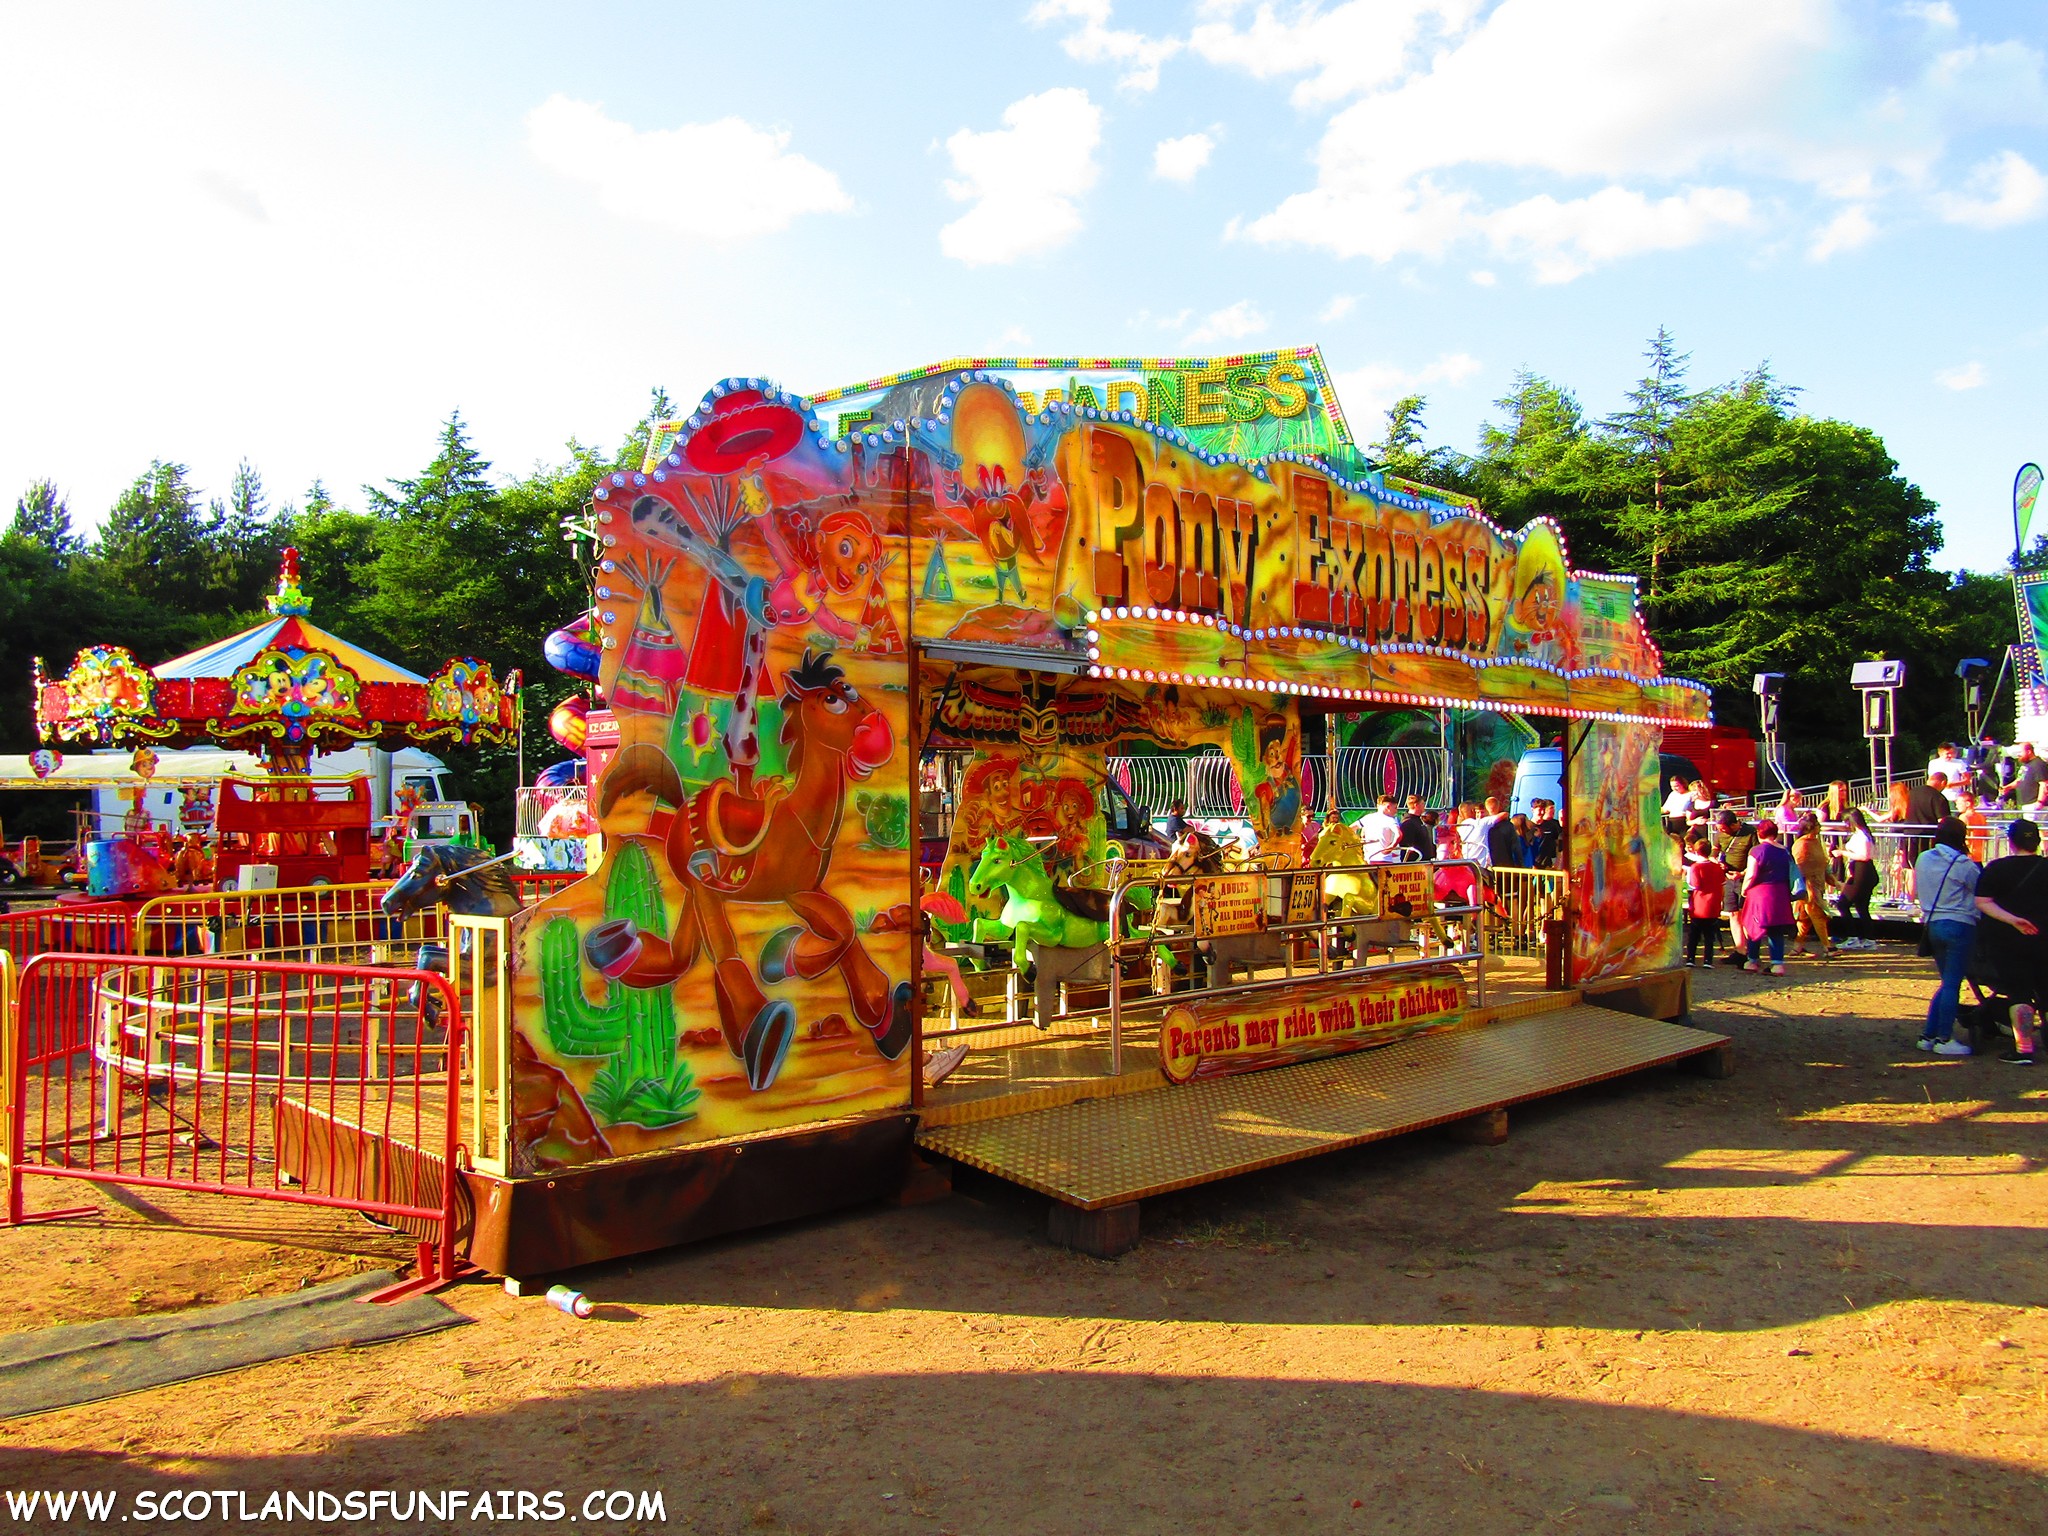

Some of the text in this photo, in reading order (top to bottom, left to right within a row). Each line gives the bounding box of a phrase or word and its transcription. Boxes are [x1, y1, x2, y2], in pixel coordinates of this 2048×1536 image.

[1090, 428, 1491, 649] Pony Express
[589, 722, 599, 733] ICE
[1295, 875, 1315, 885] FARE
[1220, 882, 1249, 896] ADULTS
[1292, 889, 1313, 909] £2.50
[1220, 909, 1253, 921] ALL RIDERS
[1169, 985, 1458, 1059] Parents may ride with their children
